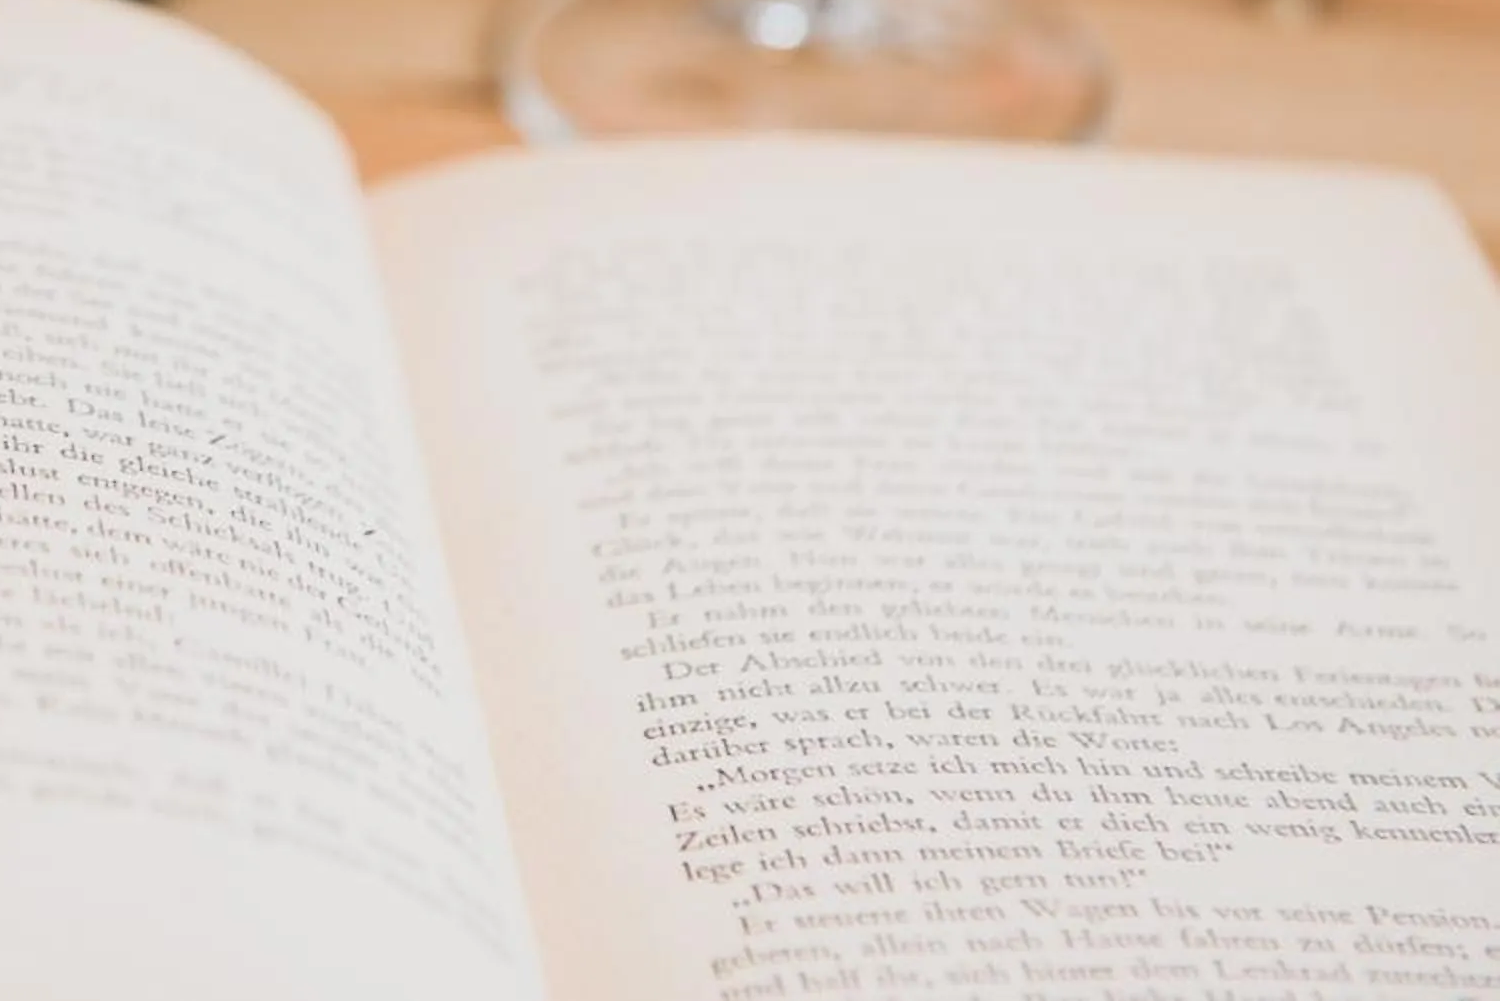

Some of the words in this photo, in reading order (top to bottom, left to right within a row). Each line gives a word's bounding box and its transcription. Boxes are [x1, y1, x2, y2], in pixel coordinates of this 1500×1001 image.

[67, 399, 124, 422] Das
[82, 425, 136, 447] war
[3, 434, 44, 454] ihr
[60, 442, 104, 465] die
[118, 455, 219, 491] gleiche
[77, 473, 214, 515] entgegen,
[230, 505, 274, 532] die
[84, 495, 131, 517] des
[808, 621, 918, 643] endlich
[662, 659, 722, 680] Der
[740, 650, 883, 673] Abschied
[900, 655, 955, 668] von
[636, 690, 699, 713] ihm
[717, 678, 796, 702] nicht
[809, 675, 883, 695] allzu
[900, 674, 1014, 694] schwer.
[1031, 679, 1069, 697] Es
[1082, 685, 1136, 700] war
[1155, 682, 1182, 706] ja
[642, 711, 757, 740] einzige,
[771, 708, 831, 725] was
[844, 706, 870, 721] er
[884, 700, 932, 721] bei
[947, 701, 994, 721] der
[1011, 702, 1165, 727] Rückfahrt
[1175, 710, 1251, 731] nach
[1264, 713, 1325, 733] Los
[1337, 715, 1458, 741] Angeles
[651, 737, 770, 768] darüber
[783, 728, 895, 756] sprach,
[905, 732, 1001, 748] waren
[1012, 728, 1058, 749] die
[1067, 730, 1180, 753] Worte:
[696, 762, 837, 792] „Morgen
[848, 760, 918, 777] setze
[929, 754, 979, 775] ich
[989, 754, 1069, 776] mich
[1076, 756, 1132, 777] hin
[1141, 759, 1205, 780] und
[1214, 761, 1339, 786] schreibe
[1349, 768, 1469, 790] meinem
[667, 800, 707, 824] Es
[722, 792, 798, 815] wäre
[811, 785, 914, 808] schön,
[927, 787, 1017, 803] wenn
[1030, 782, 1074, 803] du
[1090, 783, 1155, 805] ihm
[1164, 785, 1251, 809] heute
[1265, 789, 1359, 813] abend
[1373, 795, 1449, 816] auch
[675, 824, 778, 852] Zeilen
[791, 811, 937, 840] schriebst,
[952, 809, 1044, 832] damit
[1056, 816, 1085, 832] er
[1099, 810, 1171, 834] dich
[1183, 814, 1232, 836] ein
[1244, 817, 1344, 845] wenig
[681, 859, 746, 885] lege
[757, 849, 809, 873] ich
[821, 843, 905, 867] dann
[917, 841, 1044, 862] meinem
[1056, 839, 1148, 862] Briefe
[732, 881, 817, 908] „Das
[833, 871, 895, 895] will
[911, 870, 963, 893] ich
[979, 872, 1049, 897] gern
[739, 915, 777, 936] Er
[924, 901, 1007, 923] ihren
[1019, 897, 1141, 924] Wagen
[1151, 896, 1201, 920] bis
[1211, 903, 1263, 922] vor
[1276, 901, 1355, 925] seine
